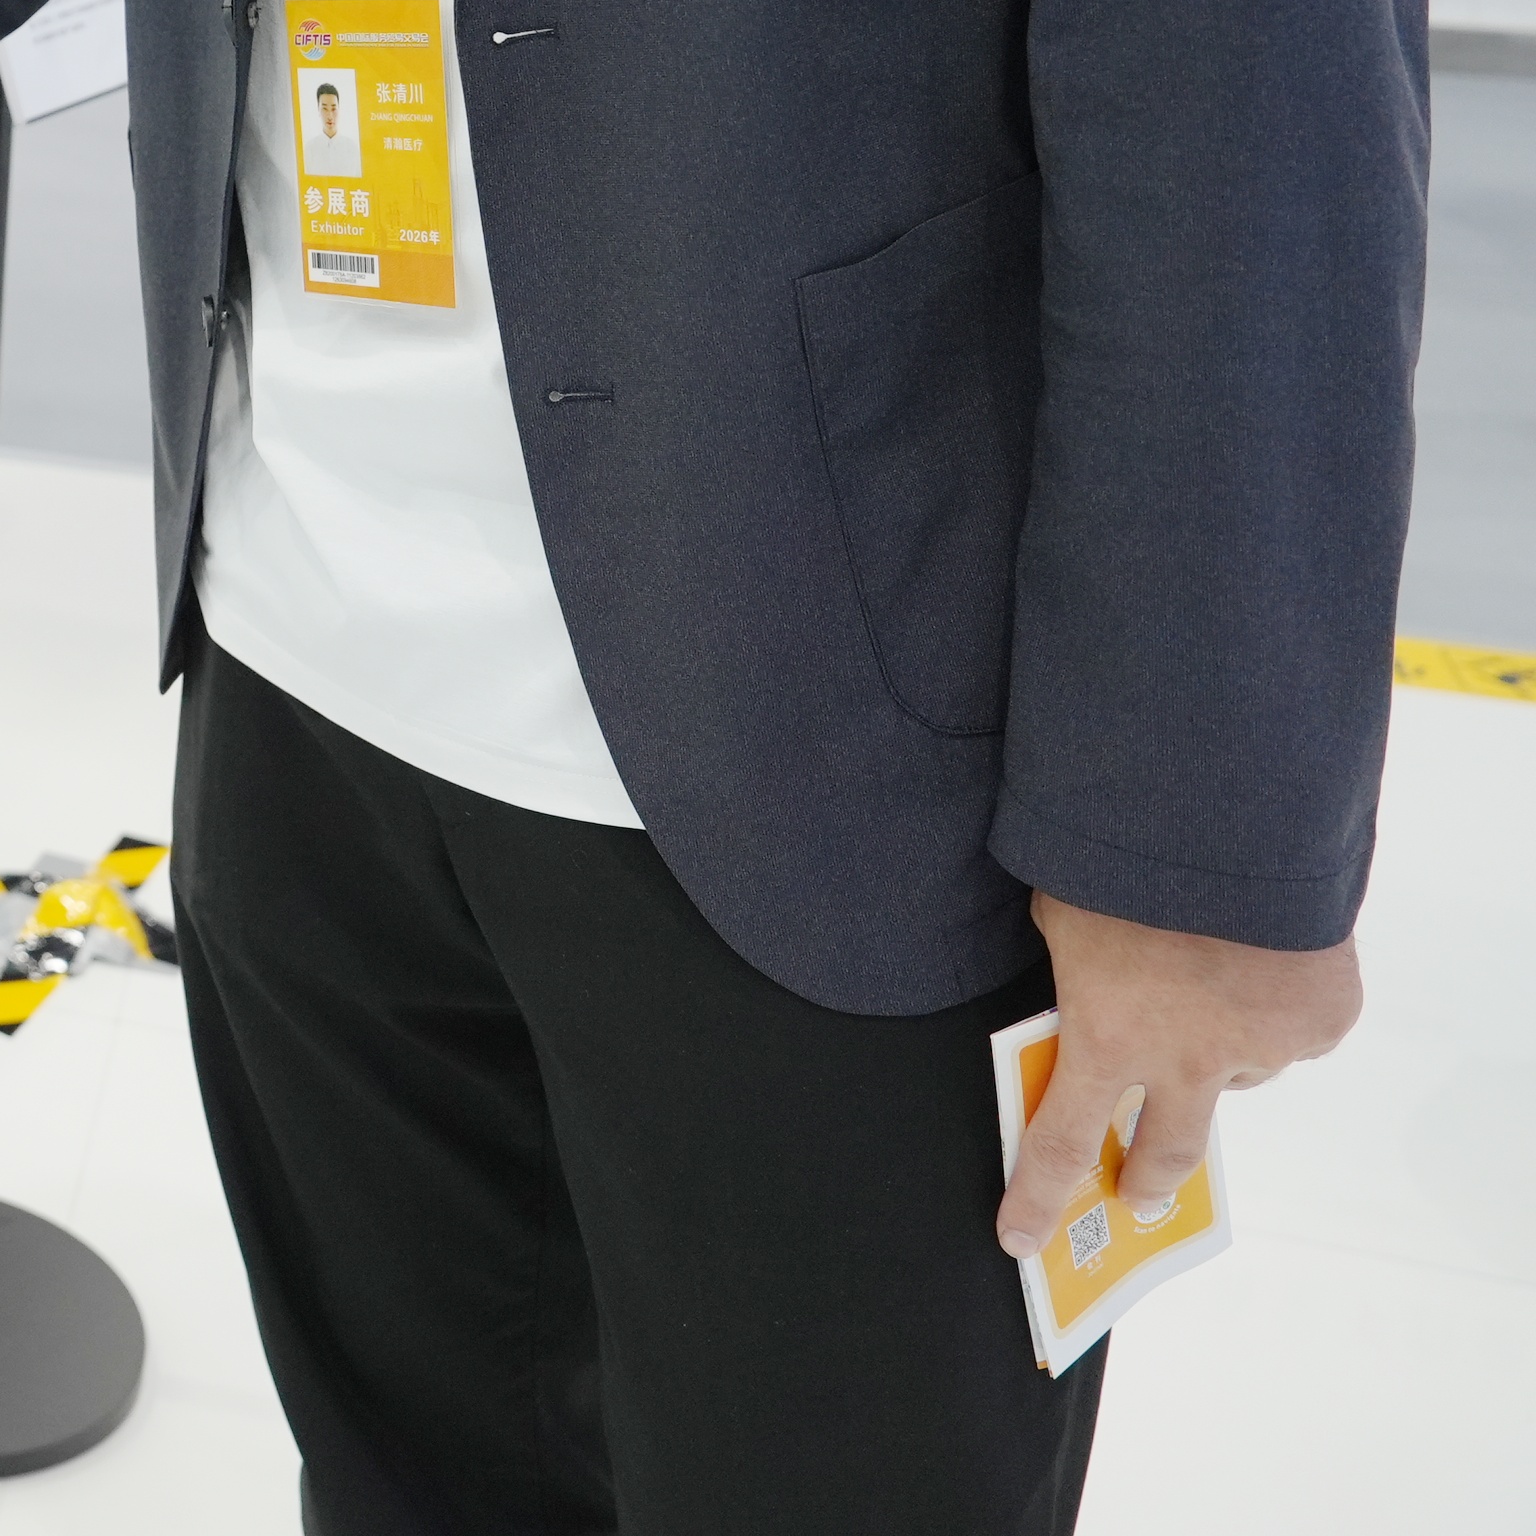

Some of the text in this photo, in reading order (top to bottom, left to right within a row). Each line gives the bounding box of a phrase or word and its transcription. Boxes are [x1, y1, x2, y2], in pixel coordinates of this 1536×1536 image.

[295, 34, 331, 46] CIFTIS
[376, 83, 424, 104] 张清川
[370, 112, 392, 121] ZHANG
[383, 137, 423, 152] 清瀚医疗
[304, 186, 371, 218] 参展商
[311, 220, 365, 237] Exhibitor
[400, 229, 440, 245] 2026年
